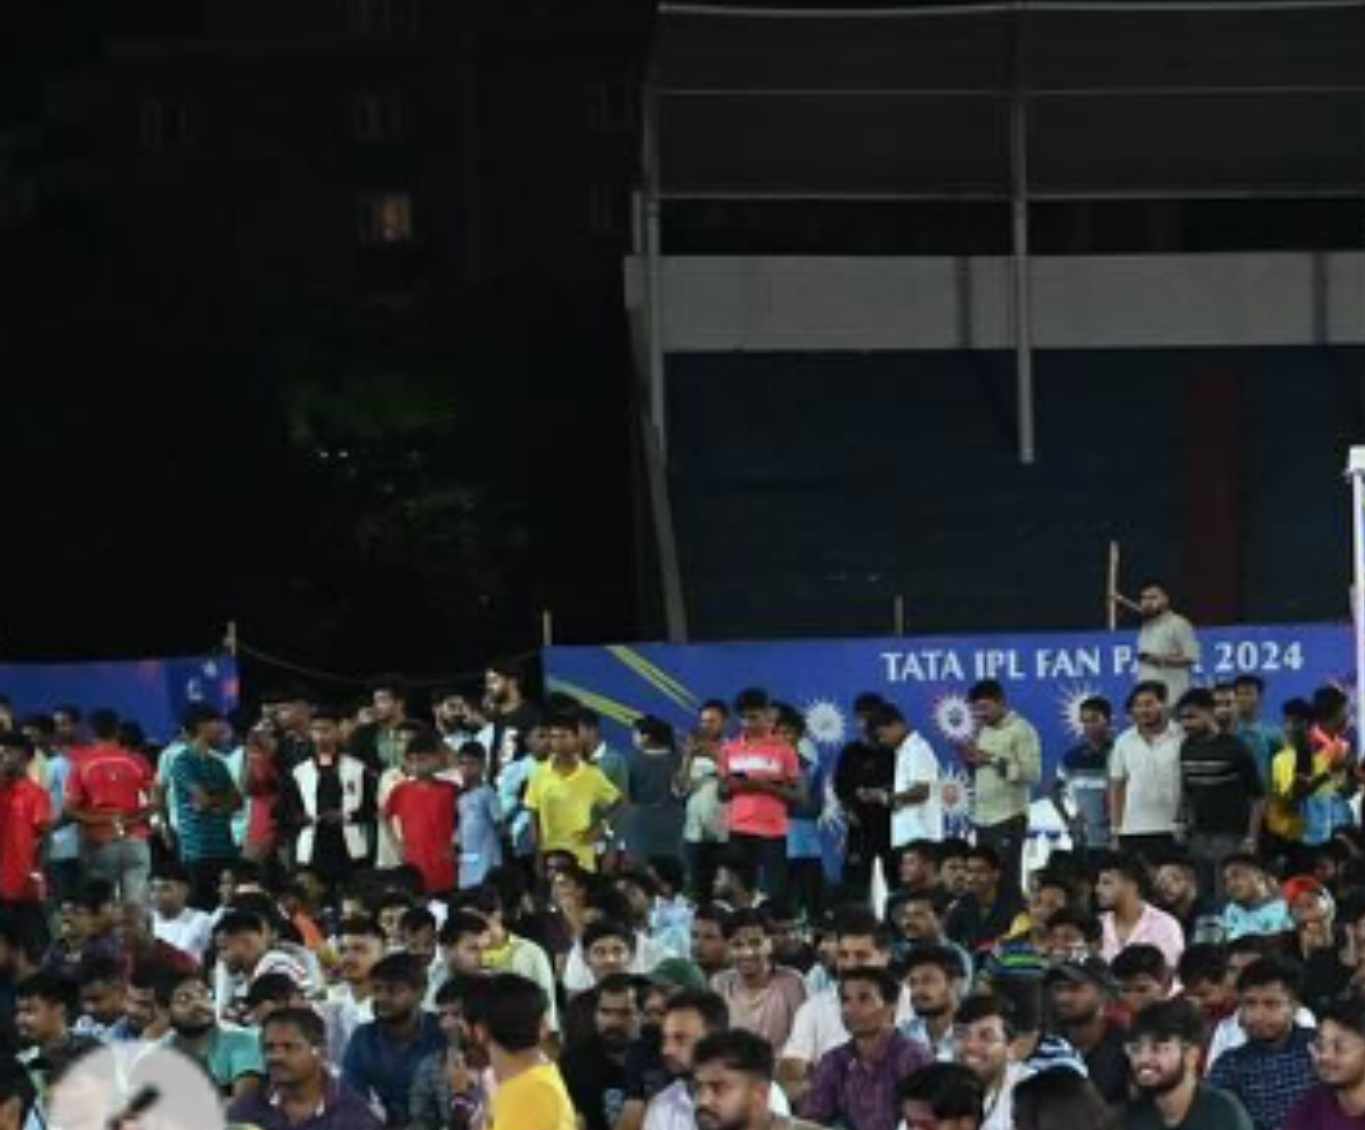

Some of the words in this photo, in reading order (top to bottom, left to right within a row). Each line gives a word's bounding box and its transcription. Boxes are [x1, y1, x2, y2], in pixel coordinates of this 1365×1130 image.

[882, 650, 965, 681] TATA
[974, 647, 1025, 680] IPL
[1036, 645, 1101, 679] FAN
[1214, 640, 1304, 671] 2024
